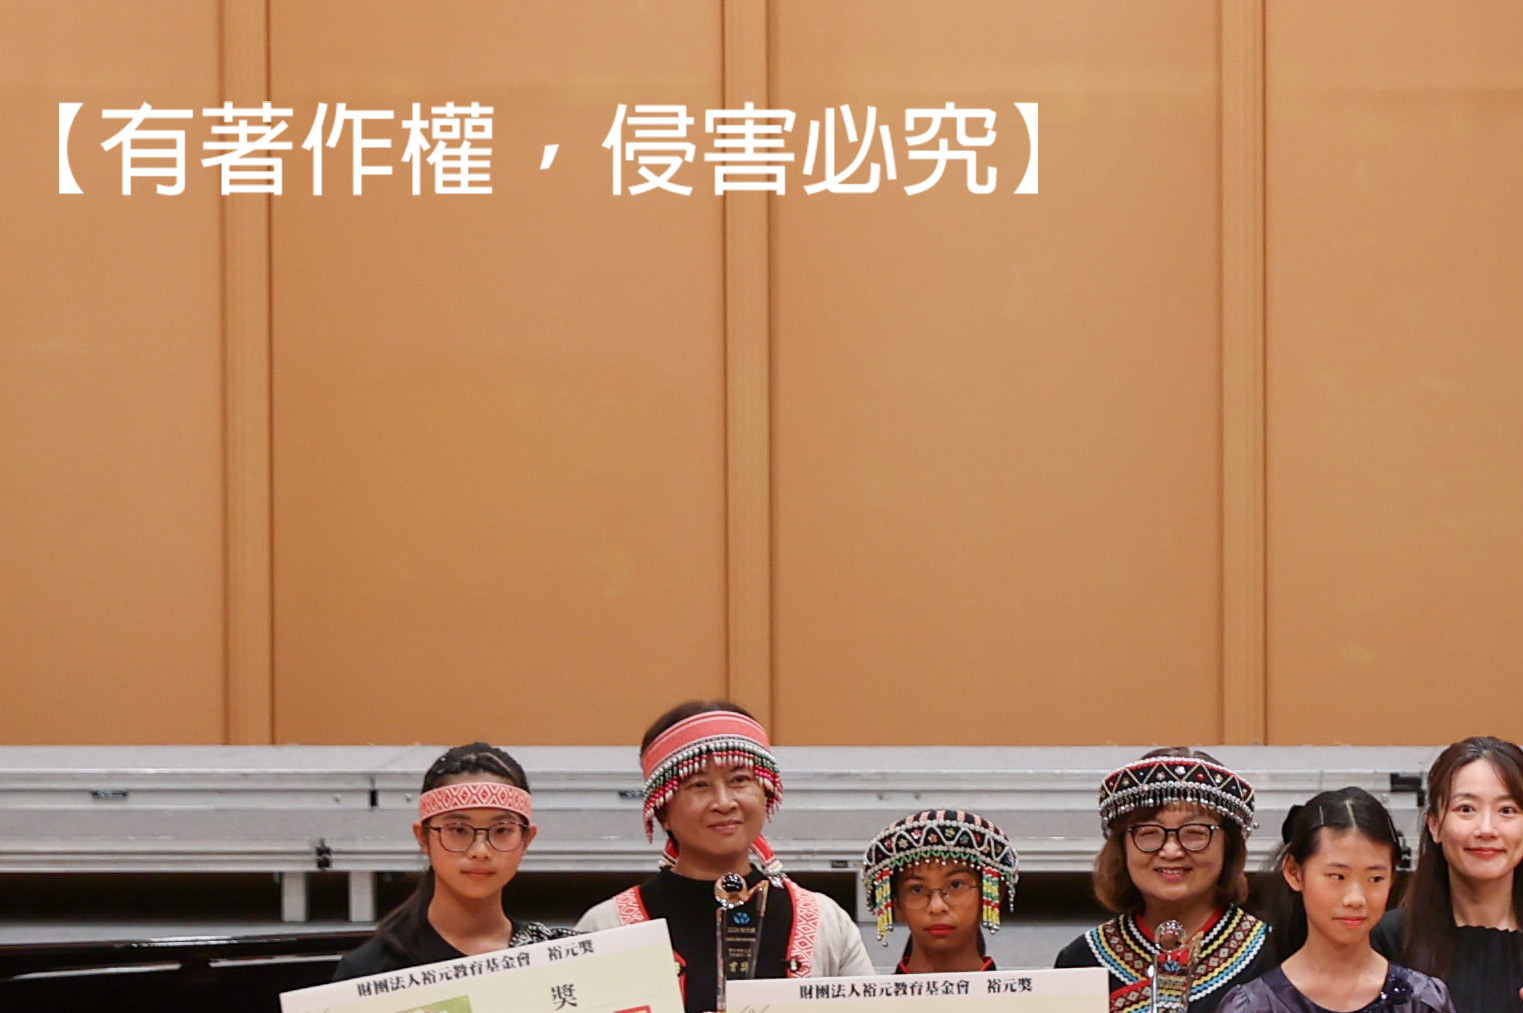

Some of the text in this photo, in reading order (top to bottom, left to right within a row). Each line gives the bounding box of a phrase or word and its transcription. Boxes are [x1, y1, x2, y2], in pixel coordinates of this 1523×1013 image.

[357, 939, 595, 997] 財團法人裕元教育基金會 裕元獎
[550, 983, 578, 1011] 獎
[799, 977, 1033, 1000] 財團法人裕元教育基金會 裕元獎
